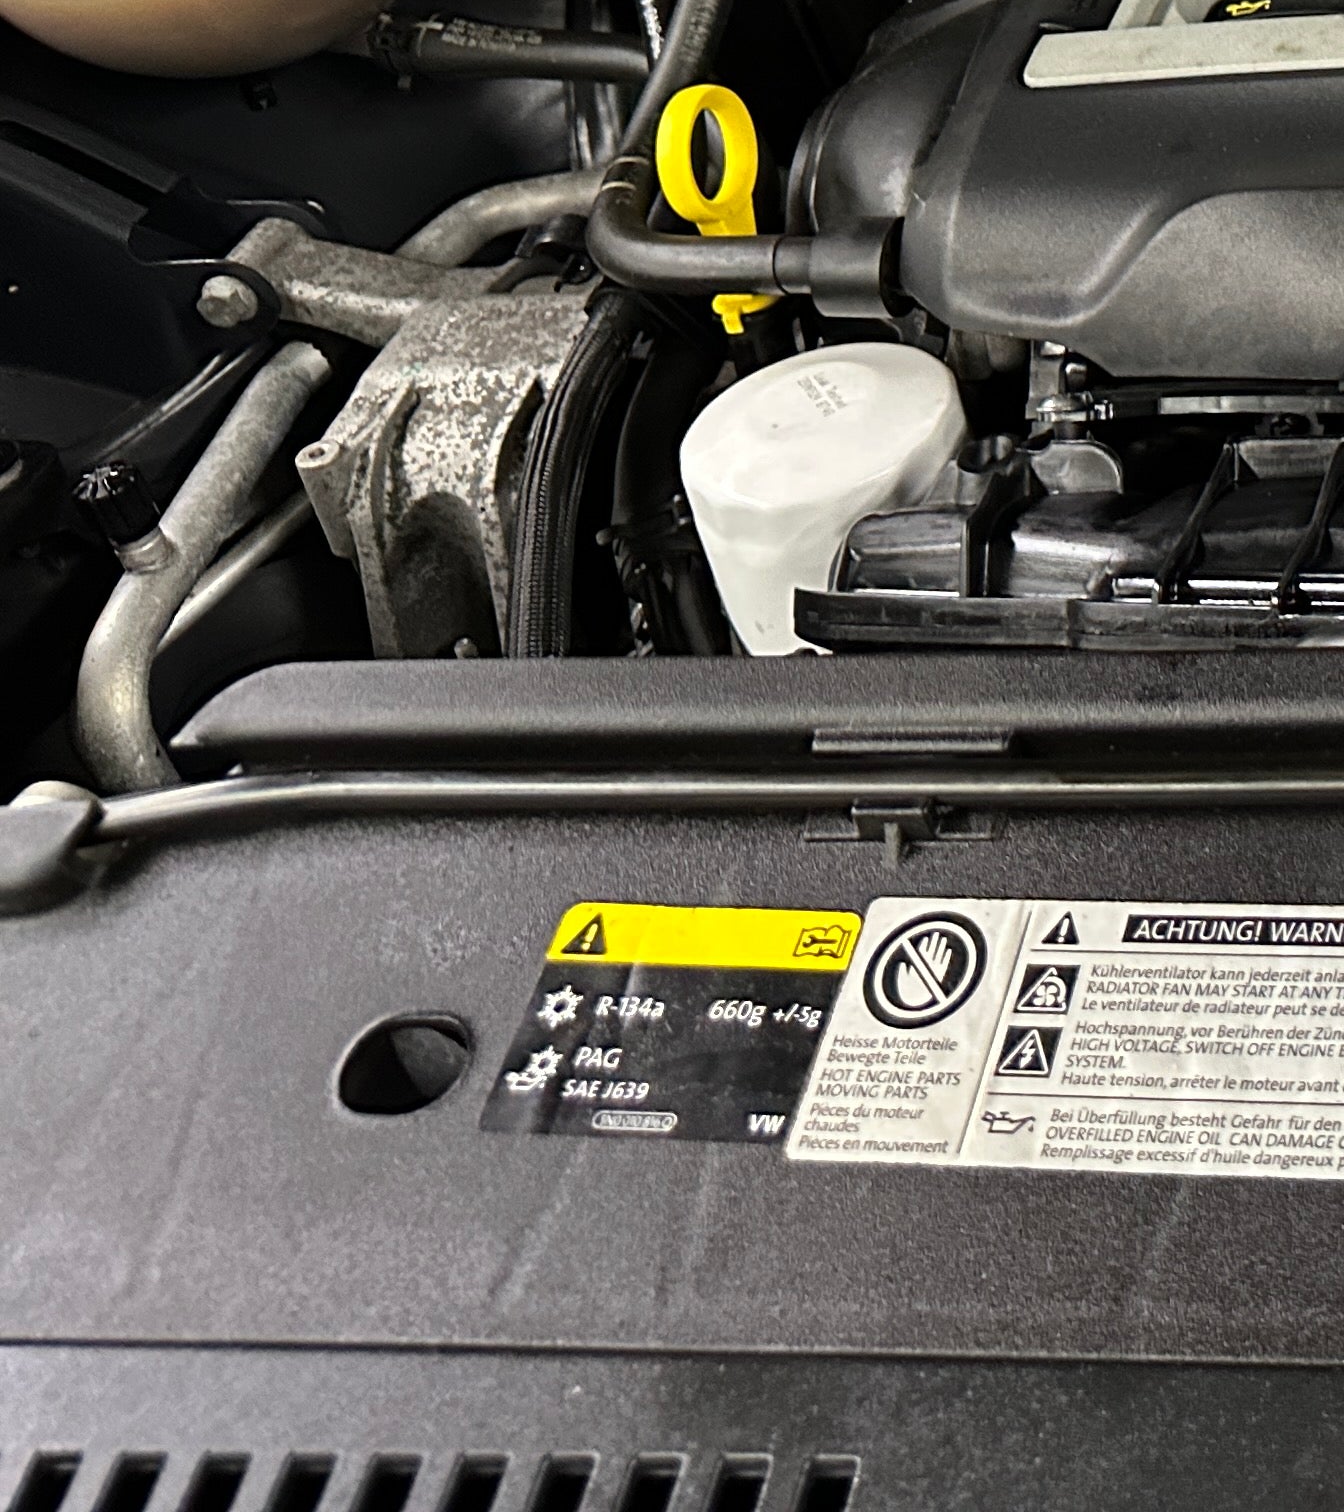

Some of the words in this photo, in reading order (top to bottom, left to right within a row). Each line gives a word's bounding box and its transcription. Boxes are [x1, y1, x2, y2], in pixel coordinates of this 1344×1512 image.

[1134, 921, 1262, 942] ACHTUNG!
[1091, 965, 1207, 980] Kühlerventilator
[1210, 967, 1244, 981] kann
[1245, 969, 1309, 986] jederzeit
[1087, 982, 1157, 996] RADIATOR
[1162, 983, 1191, 996] FAN
[1195, 984, 1229, 997] MAY
[1233, 984, 1274, 998] START
[1278, 986, 1298, 998] AT
[1300, 986, 1333, 1000] ANY
[595, 998, 665, 1018] R-134a
[709, 1000, 764, 1025] 660g
[773, 1005, 821, 1027] +/-5g
[1075, 1021, 1187, 1042] Hochspannung,
[1191, 1026, 1215, 1038] vor
[1217, 1025, 1284, 1040] Berühren
[1287, 1028, 1311, 1040] der
[833, 1035, 879, 1048] Heisse
[882, 1037, 958, 1051] Motorteile
[1070, 1039, 1109, 1051] HIGH
[1114, 1041, 1183, 1055] VOLTAGE,
[1186, 1042, 1244, 1055] SWITCH
[1247, 1043, 1274, 1056] OFF
[1278, 1044, 1334, 1058] ENGINE
[575, 1047, 622, 1069] PAG
[827, 1049, 890, 1066] Bewegte
[893, 1051, 926, 1064] Teile
[1065, 1056, 1124, 1069] SYSTEM.
[820, 1069, 854, 1081] HOT
[856, 1070, 912, 1084] ENGINE
[917, 1072, 960, 1085] PARTS
[562, 1081, 597, 1098] SAE
[603, 1082, 649, 1099] J639
[815, 1084, 878, 1097] MOVING
[884, 1086, 928, 1099] PARTS
[749, 1115, 786, 1133] VW
[1046, 1127, 1133, 1143] OVERFILLED
[1137, 1129, 1194, 1144] ENGINE
[1198, 1130, 1222, 1145] OIL
[1229, 1132, 1260, 1146] CAN
[1265, 1132, 1333, 1148] DAMAGE
